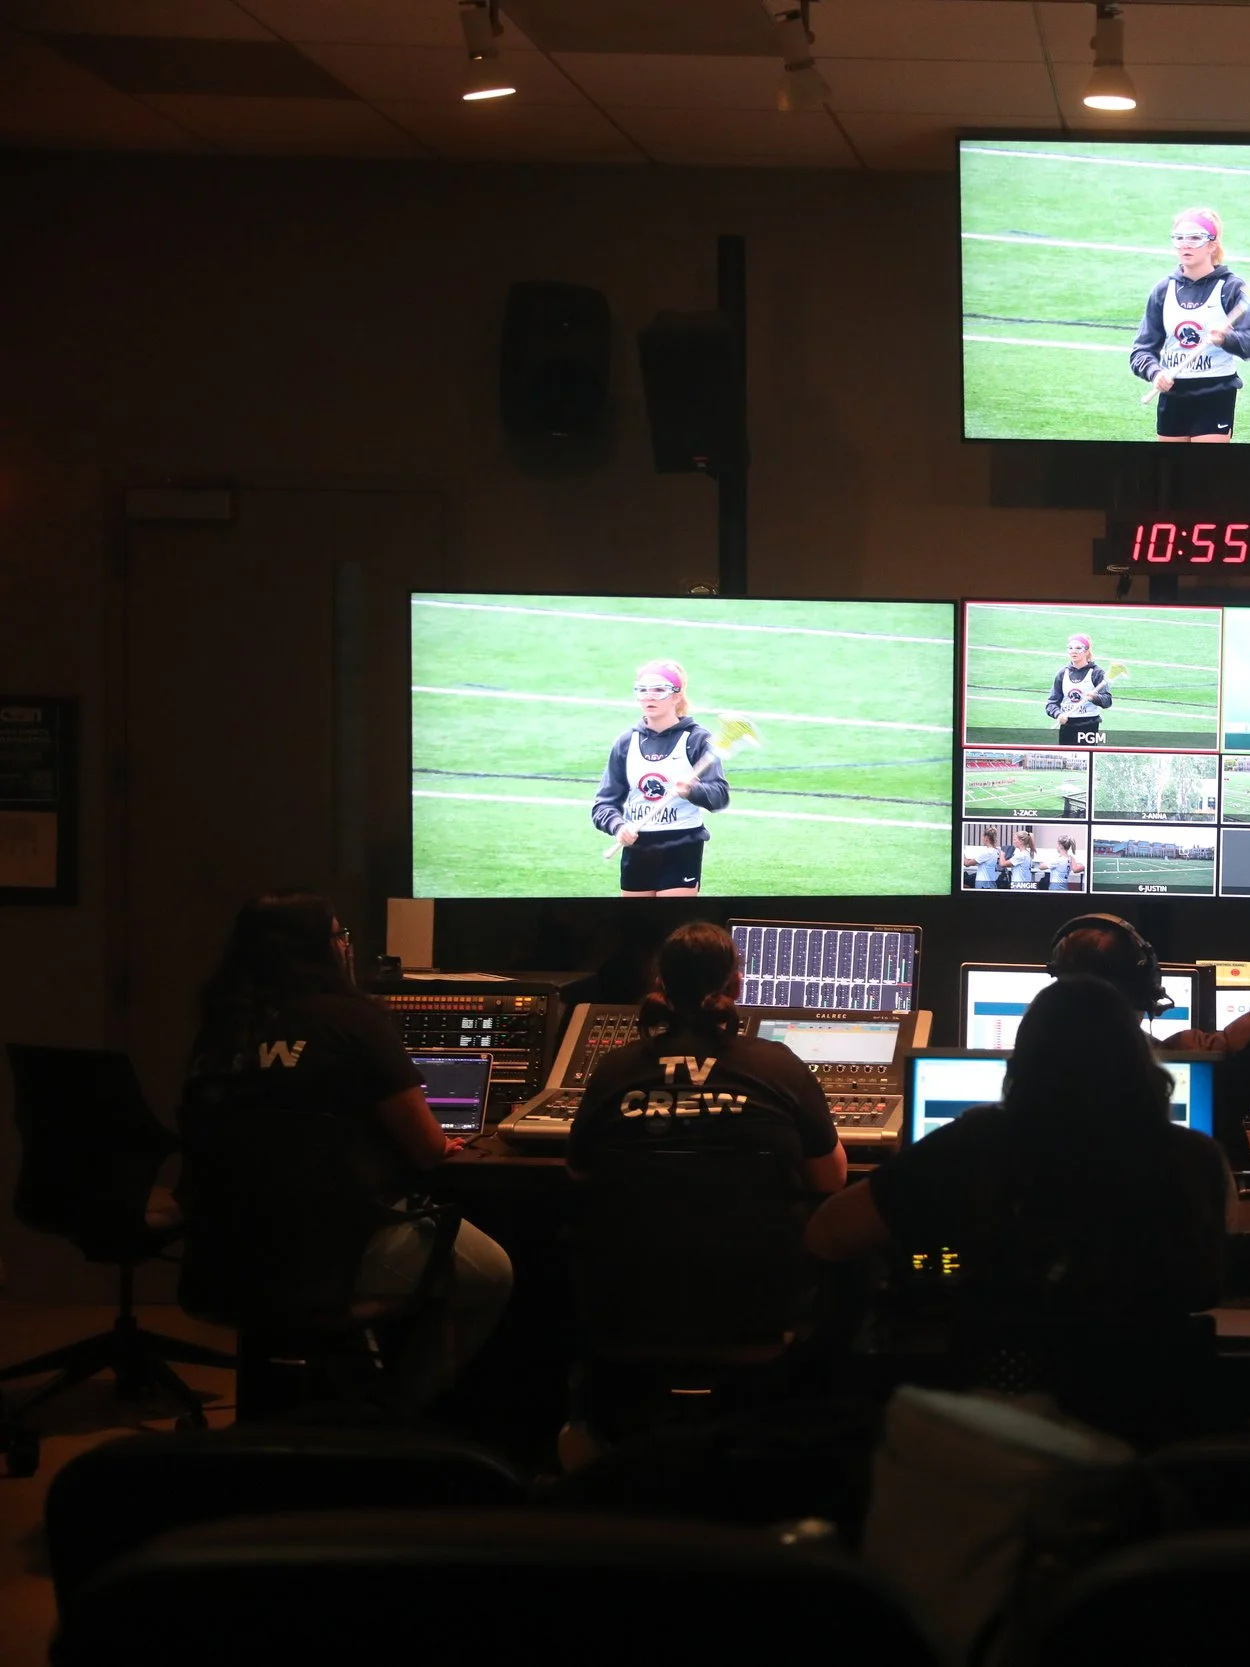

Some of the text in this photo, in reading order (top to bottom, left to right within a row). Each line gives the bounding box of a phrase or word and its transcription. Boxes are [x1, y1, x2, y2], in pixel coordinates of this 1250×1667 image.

[1077, 732, 1106, 744] PGM
[1013, 809, 1038, 817] 1-ZACK
[1141, 812, 1167, 821] 2-ANNA
[1010, 881, 1038, 890] 5-ANGIE
[1138, 884, 1168, 893] 6-JUSTIN
[658, 1055, 718, 1086] TV
[620, 1090, 748, 1118] CREW
